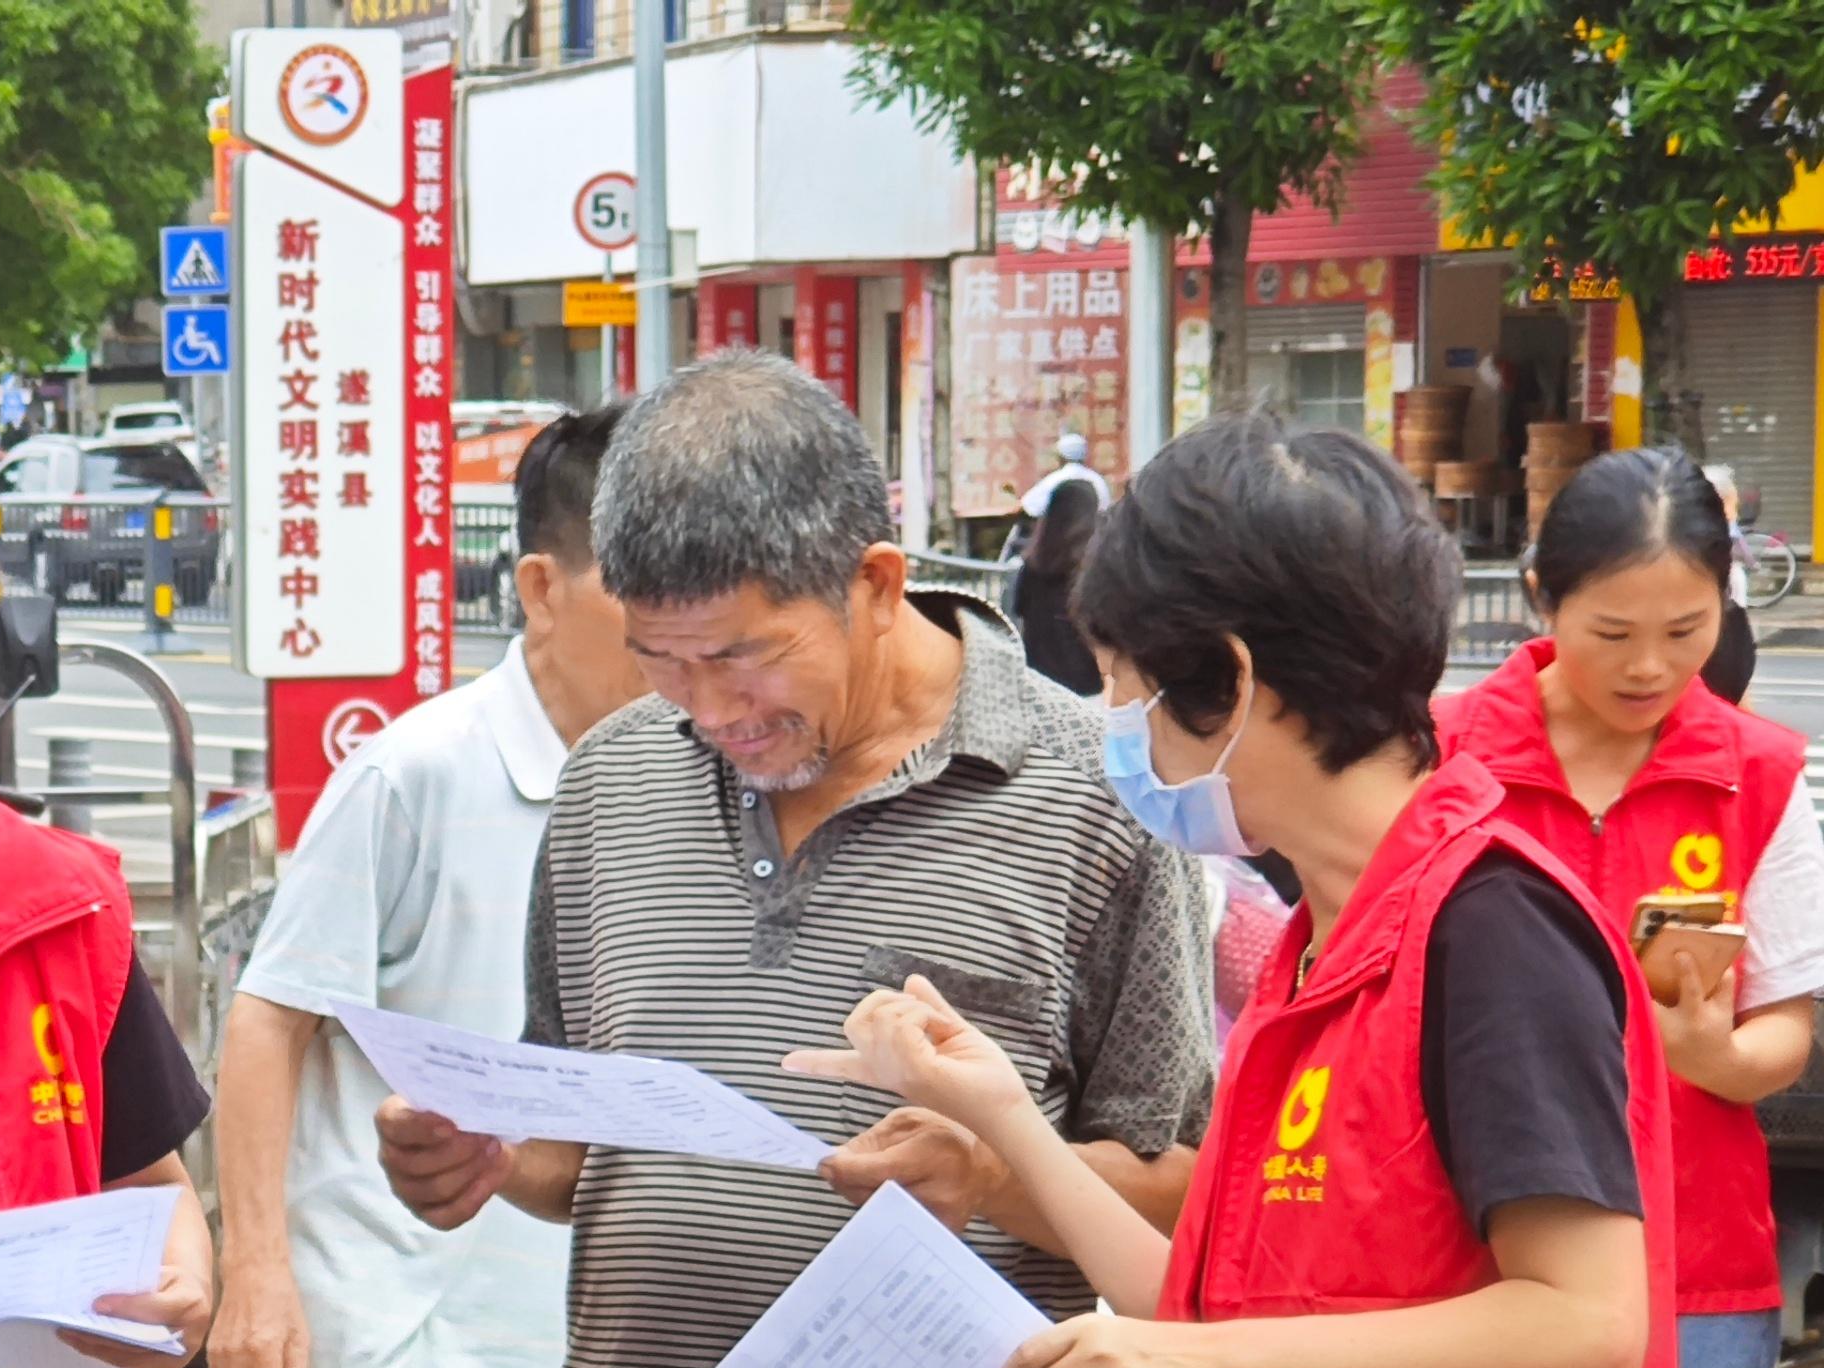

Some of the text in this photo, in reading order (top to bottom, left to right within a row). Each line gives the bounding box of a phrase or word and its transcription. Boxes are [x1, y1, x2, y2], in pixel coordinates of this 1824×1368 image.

[591, 192, 630, 229] 5t
[963, 269, 1121, 322] 床上用品
[963, 324, 1120, 364] 厂家直供点
[278, 219, 321, 657] 新时代文明实践中心
[337, 369, 372, 508] 遂溪县
[413, 117, 443, 696] 凝聚群众 引导群众 以文化人 成风化俗
